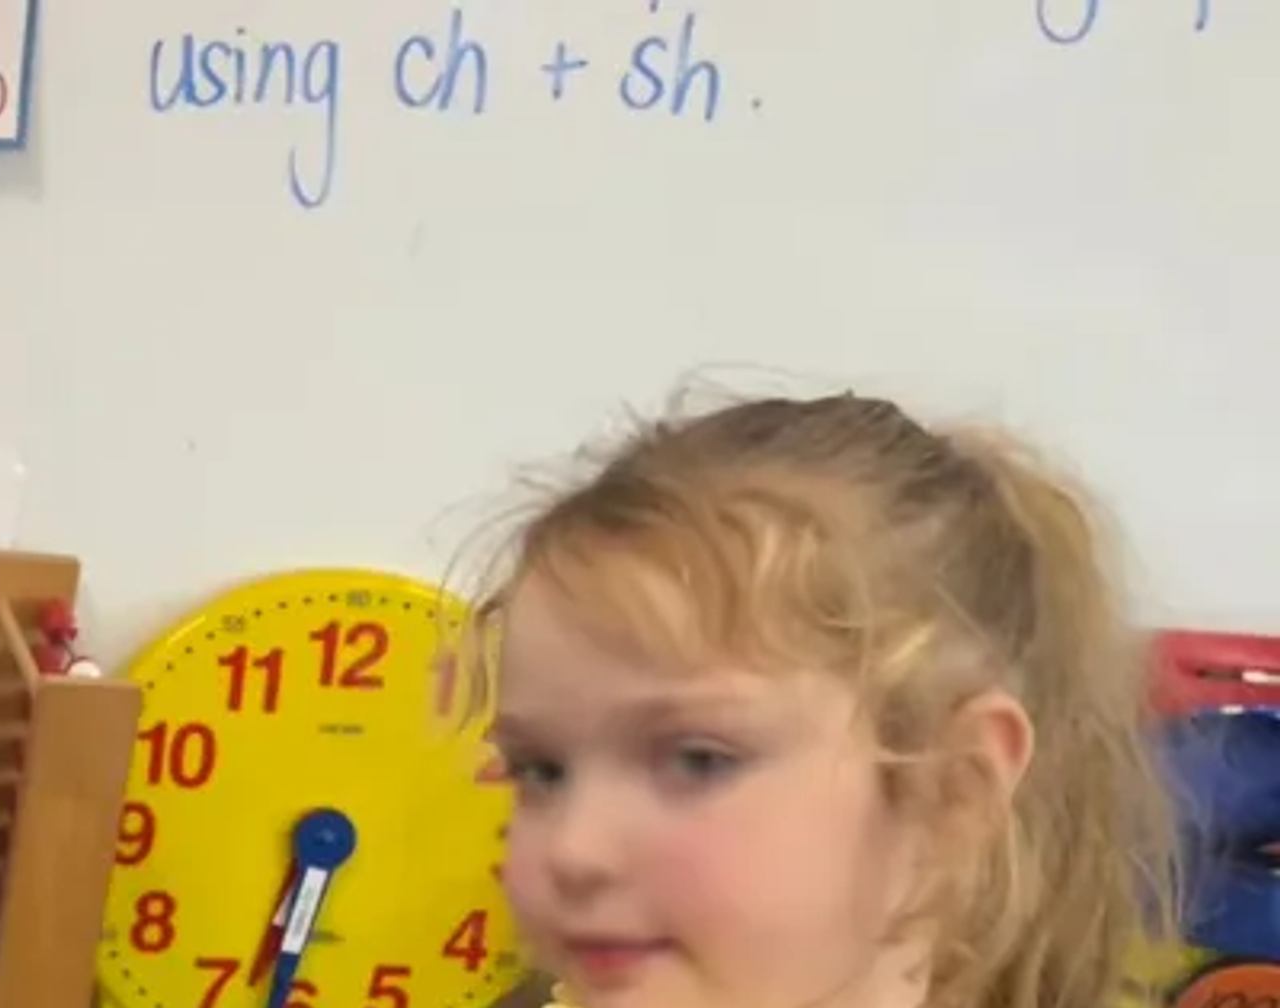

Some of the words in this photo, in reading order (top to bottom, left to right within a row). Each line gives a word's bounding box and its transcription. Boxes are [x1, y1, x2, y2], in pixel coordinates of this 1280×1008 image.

[148, 26, 339, 210] using
[393, 8, 488, 114] ch
[543, 40, 589, 100] +
[217, 645, 284, 714] 11
[309, 619, 390, 689] 12
[138, 721, 217, 788] 10
[115, 802, 157, 866] 9
[130, 891, 176, 954] 8
[441, 909, 489, 972] 4
